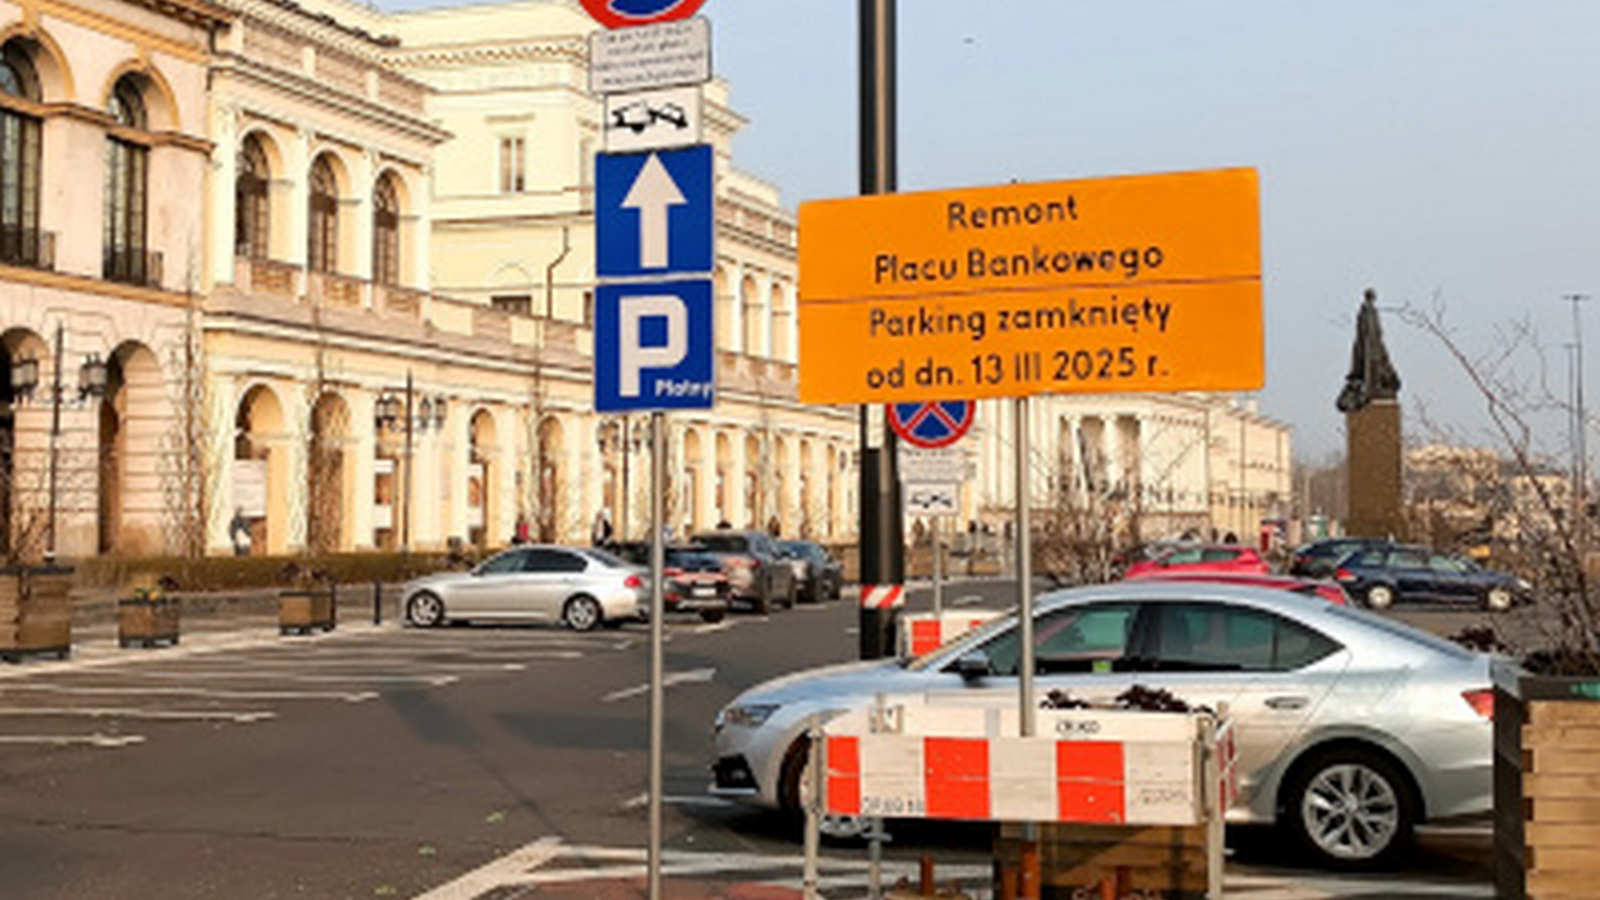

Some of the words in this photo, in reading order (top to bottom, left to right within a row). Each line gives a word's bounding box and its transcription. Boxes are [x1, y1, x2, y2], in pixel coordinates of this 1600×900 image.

[947, 194, 1078, 229] Remont
[874, 255, 958, 284] Placu
[966, 242, 1165, 279] Bankowego
[868, 307, 987, 342] Parking
[997, 296, 1173, 334] zamknięty
[619, 294, 688, 397] P
[865, 359, 905, 390] od
[914, 358, 964, 388] dn.
[970, 353, 1004, 385] 13
[1014, 352, 1042, 382] III
[1051, 346, 1137, 381] 2025
[1147, 355, 1170, 379] r.
